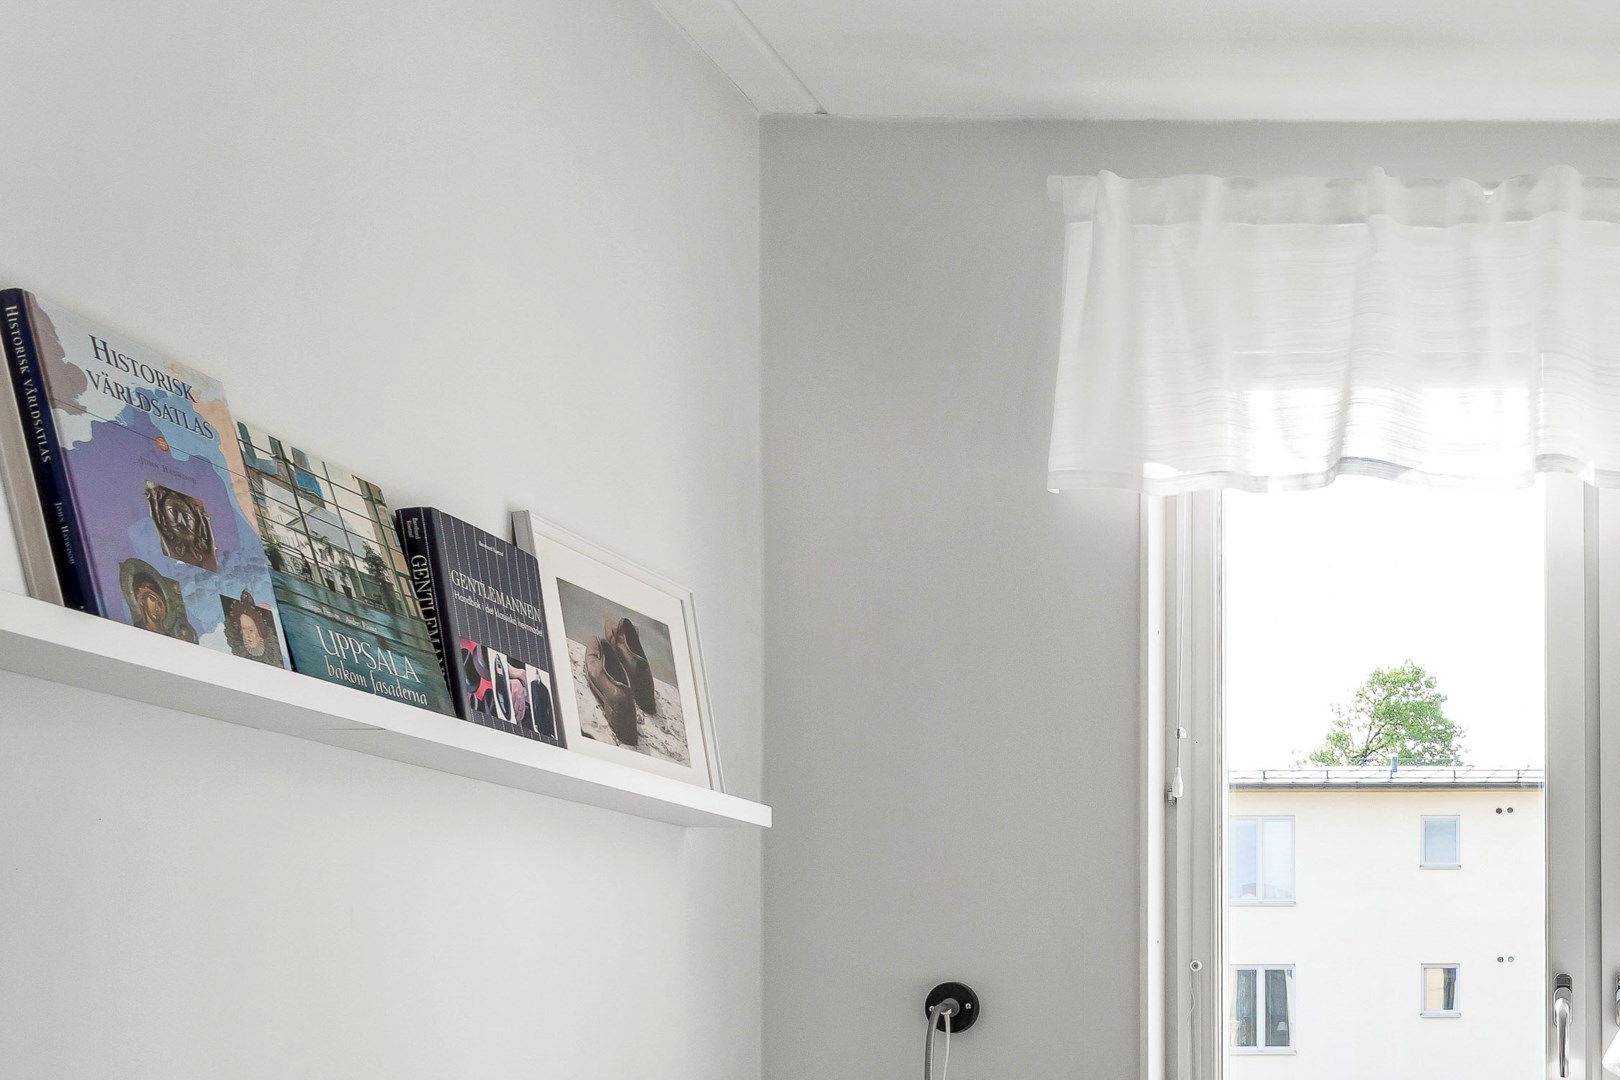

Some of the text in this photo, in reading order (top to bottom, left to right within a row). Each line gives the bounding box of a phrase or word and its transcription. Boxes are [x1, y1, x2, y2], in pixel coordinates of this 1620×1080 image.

[5, 305, 51, 462] HISTORISK VÄRLDSATLAS
[88, 334, 198, 404] HISTORISK
[85, 369, 214, 441] VÄRLDSATLAS
[450, 569, 541, 623] GENTLEMANNEN
[315, 625, 421, 683] UPPSALA
[324, 655, 428, 706] bakom fasaderna
